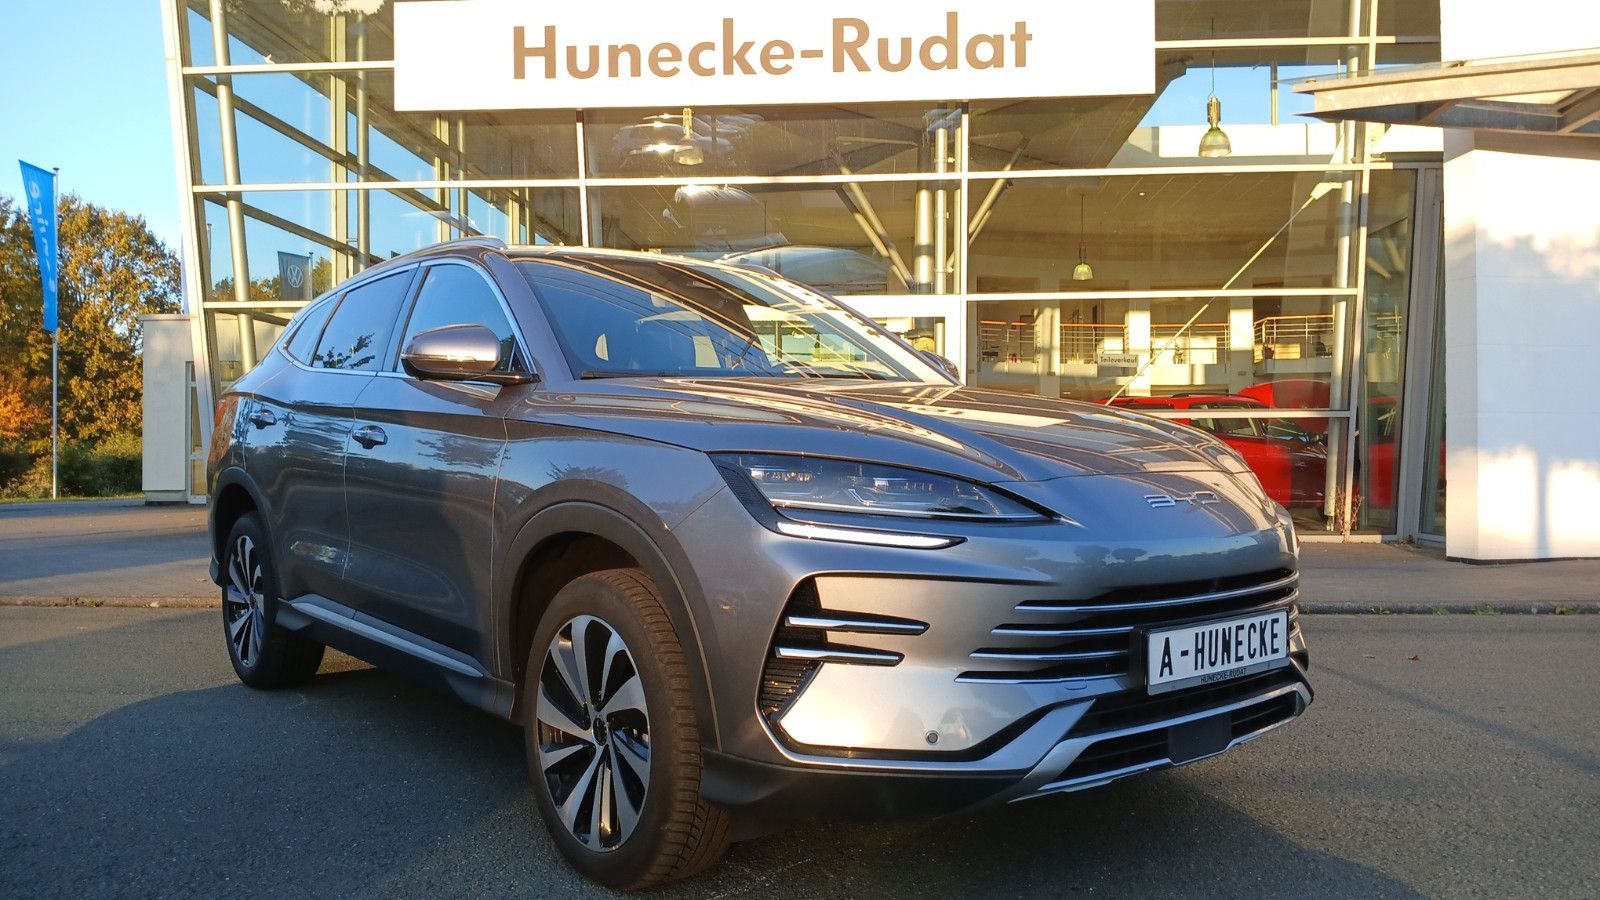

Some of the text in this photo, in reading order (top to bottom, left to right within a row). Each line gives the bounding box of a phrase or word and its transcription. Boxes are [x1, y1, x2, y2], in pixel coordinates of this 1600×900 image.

[513, 11, 1033, 80] Hunecke-Rudat
[1100, 356, 1137, 364] Teileverkauf
[1200, 667, 1247, 684] HUNECKE-RUDAT
